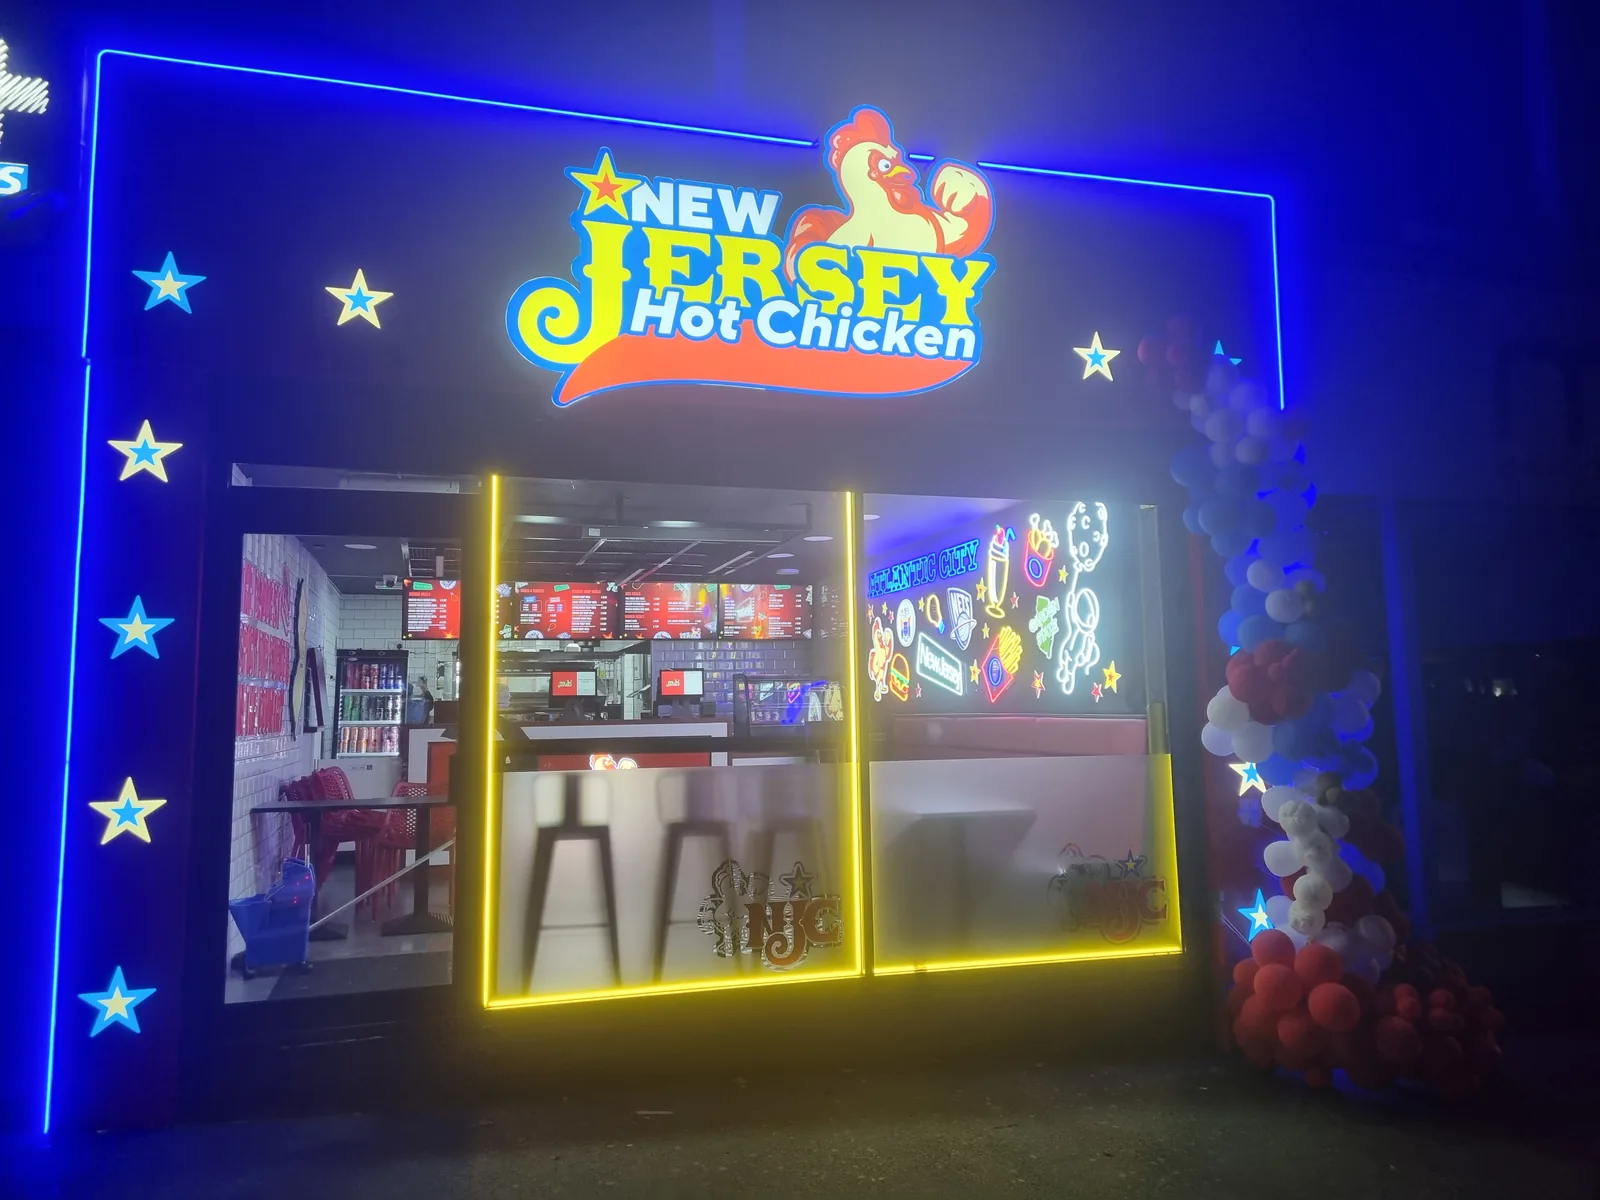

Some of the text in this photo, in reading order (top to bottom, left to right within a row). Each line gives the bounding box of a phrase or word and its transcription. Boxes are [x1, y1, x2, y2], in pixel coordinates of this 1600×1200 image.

[630, 182, 778, 235] NEW
[517, 220, 990, 364] JERSEY
[630, 288, 976, 358] Hot Chicken
[868, 538, 980, 599] ATLANTIC CITY
[951, 592, 971, 624] NETS
[920, 642, 940, 673] New
[940, 656, 960, 691] Jersey
